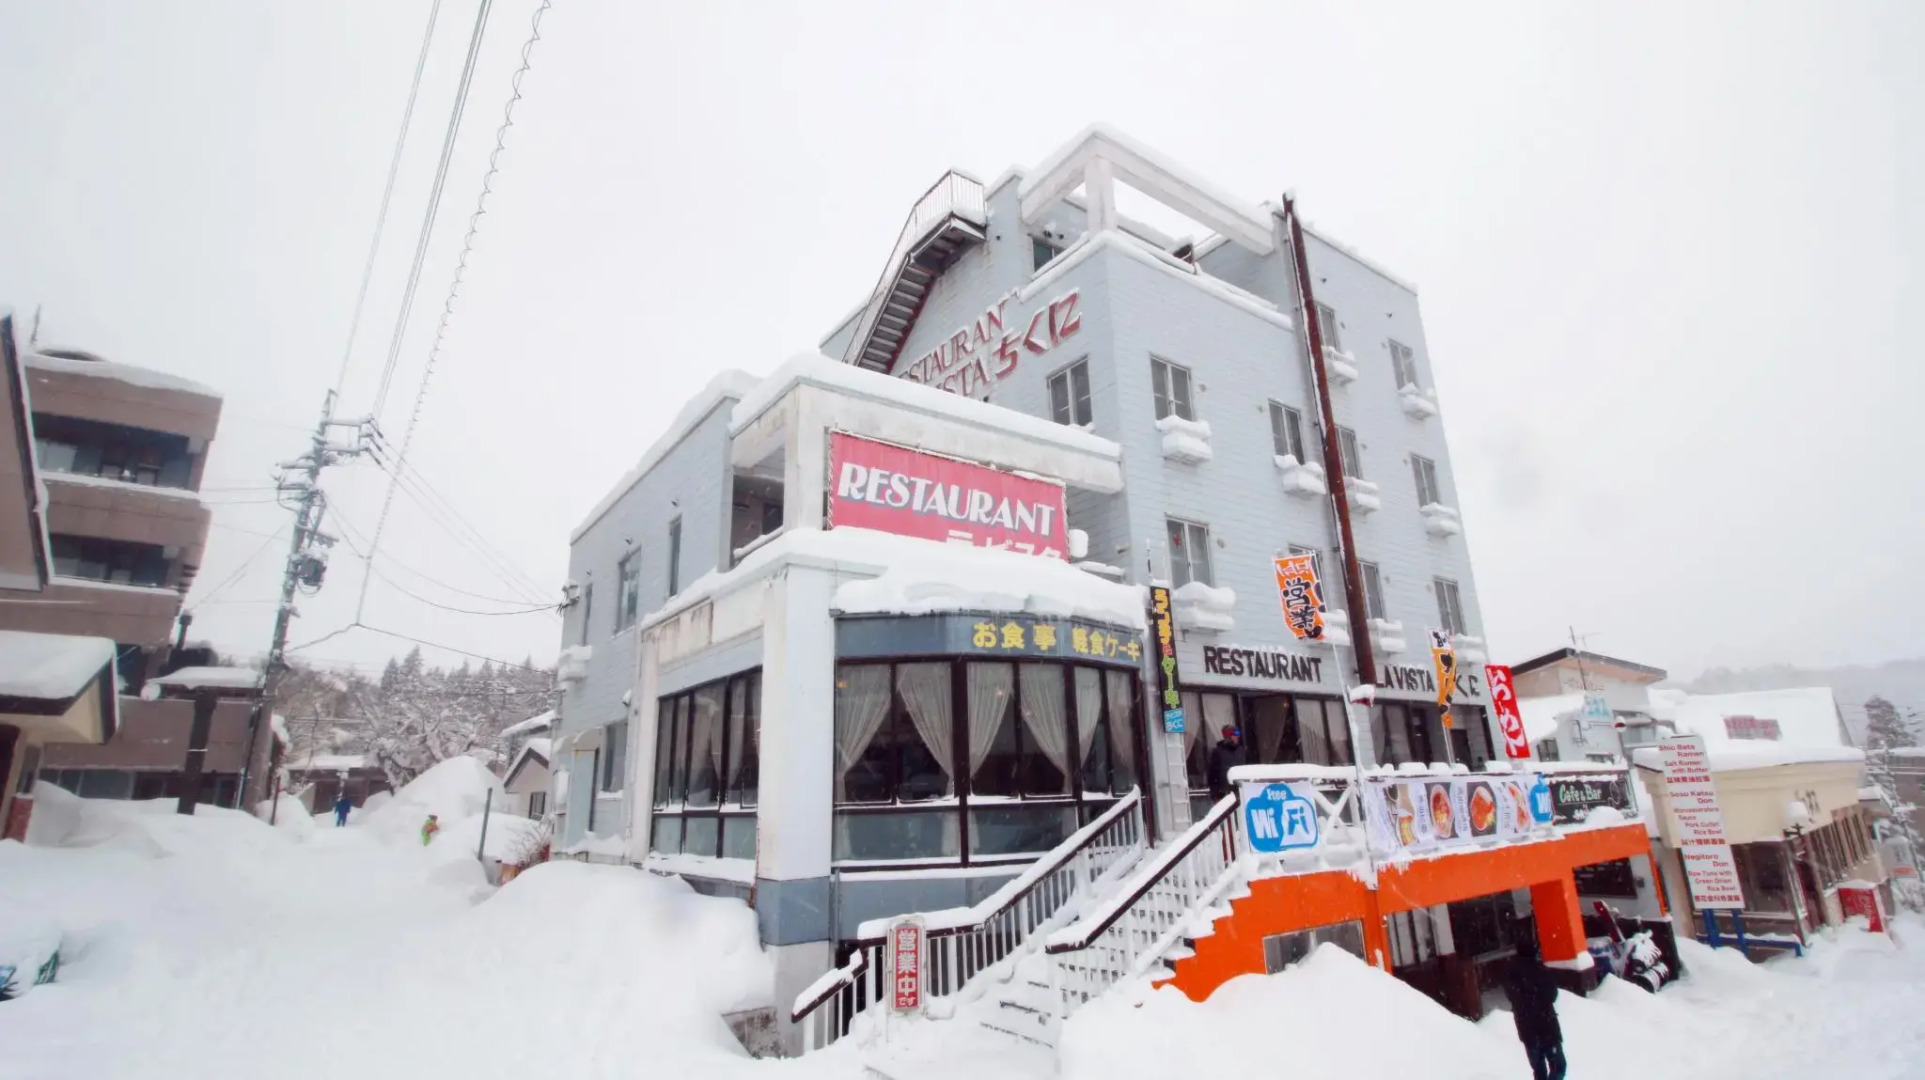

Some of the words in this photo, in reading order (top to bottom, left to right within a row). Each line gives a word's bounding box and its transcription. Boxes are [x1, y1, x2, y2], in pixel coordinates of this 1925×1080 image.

[837, 461, 1056, 537] RESTAURANT
[972, 621, 1056, 650] お食事
[1203, 645, 1322, 683] RESTAURANT
[1559, 783, 1580, 802] Cafe
[1585, 784, 1602, 800] Bar
[1684, 853, 1719, 861] Negitoro
